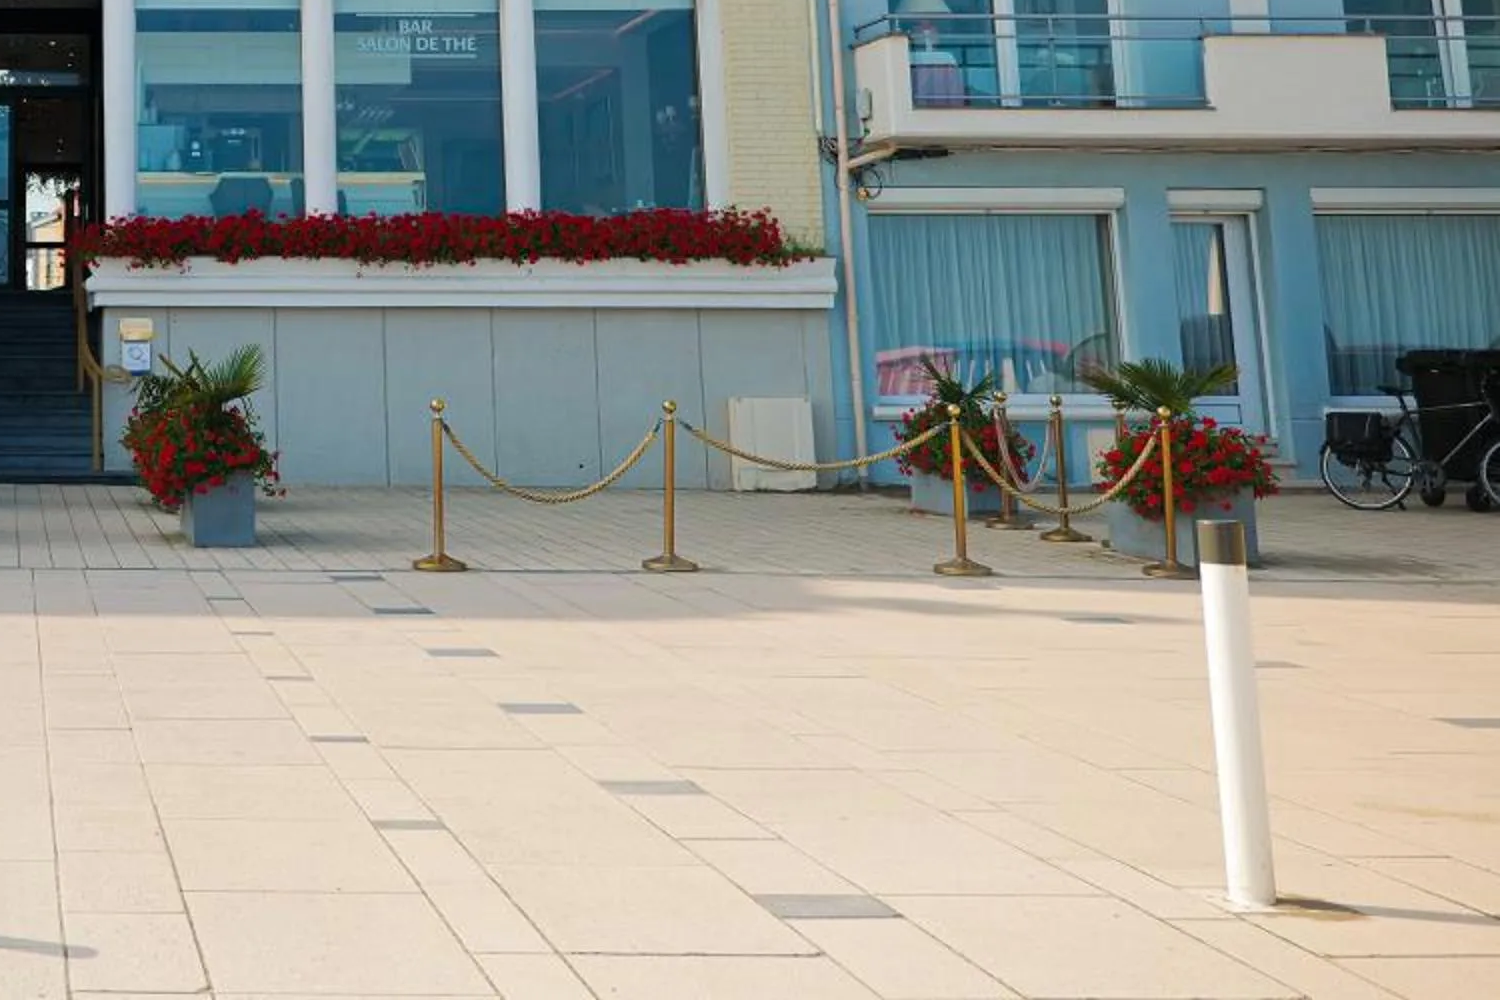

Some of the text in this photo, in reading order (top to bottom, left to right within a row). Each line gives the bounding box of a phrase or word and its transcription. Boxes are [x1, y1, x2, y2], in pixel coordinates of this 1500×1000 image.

[399, 19, 433, 35] BAR
[357, 36, 411, 52] SALON
[415, 36, 439, 51] DE
